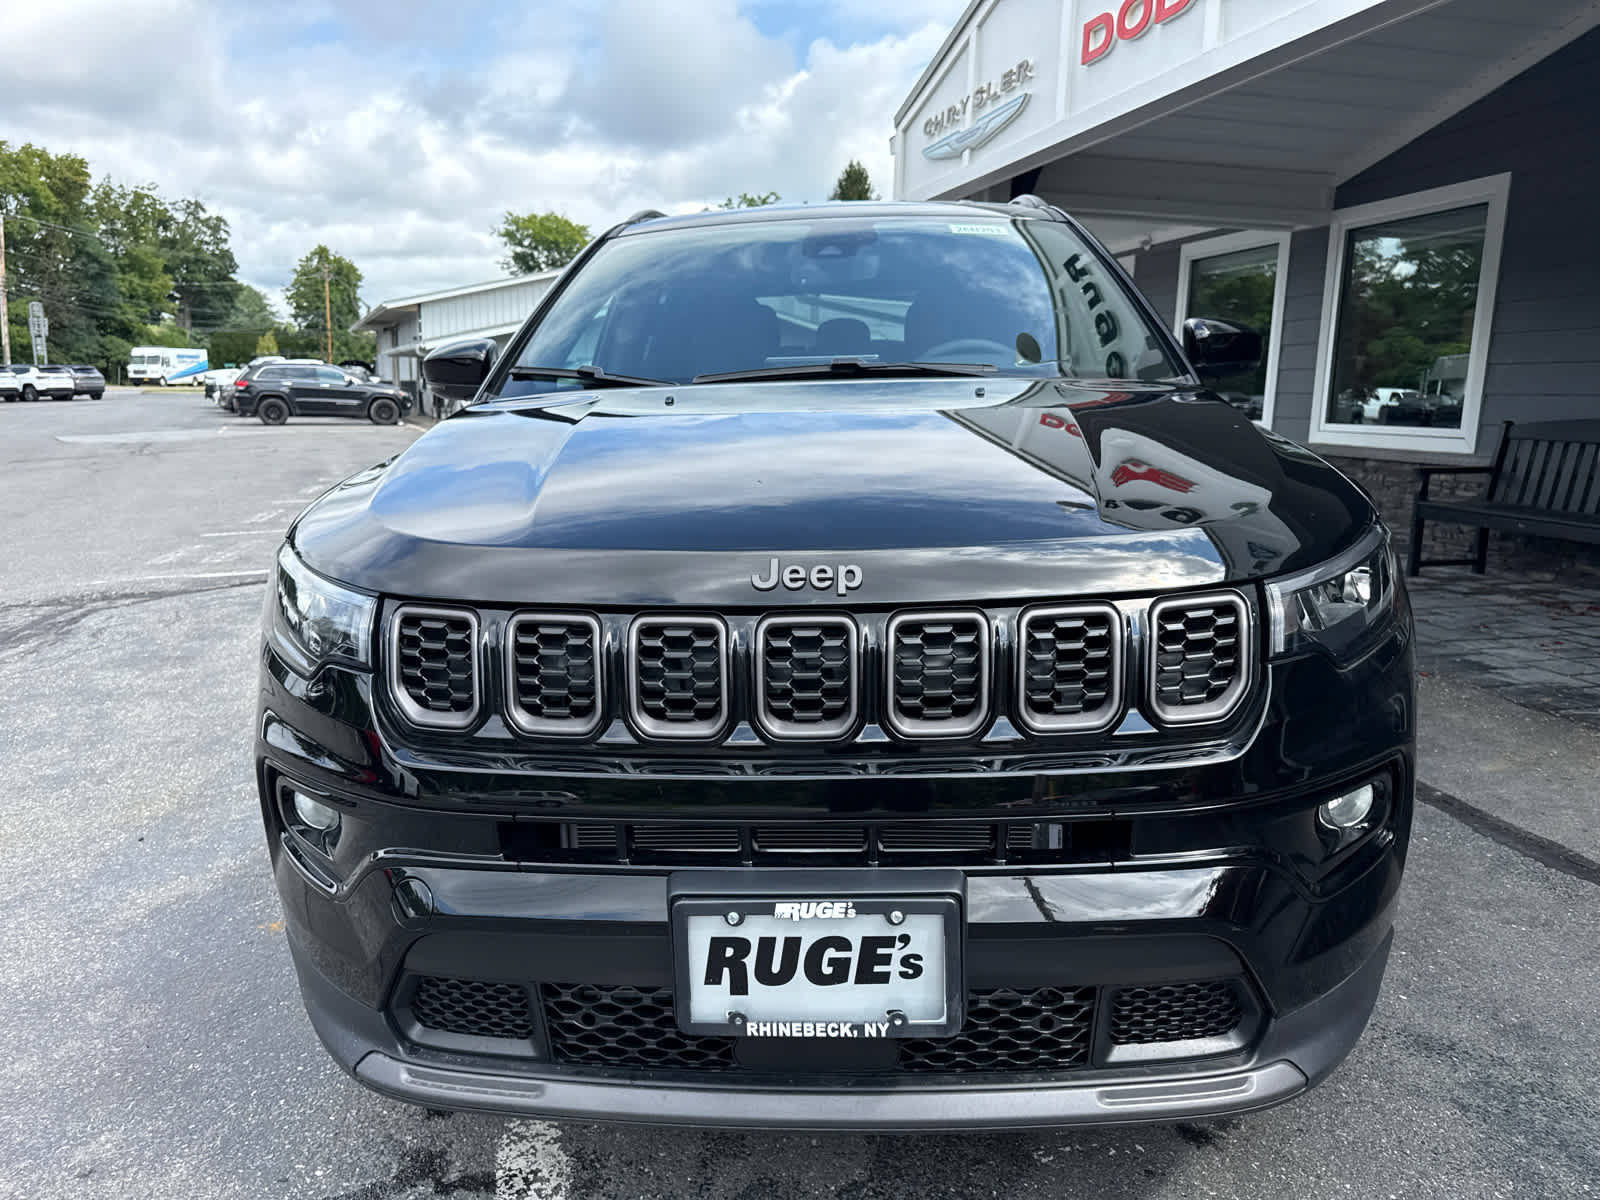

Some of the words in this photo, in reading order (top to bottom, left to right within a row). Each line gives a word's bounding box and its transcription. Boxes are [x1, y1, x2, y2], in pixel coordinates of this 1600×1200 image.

[1081, 0, 1196, 66] DO
[924, 59, 1034, 137] CHRYSLER
[752, 557, 863, 597] Jeep
[746, 1022, 858, 1037] RHINEBECK,
[864, 1022, 890, 1037] NY
